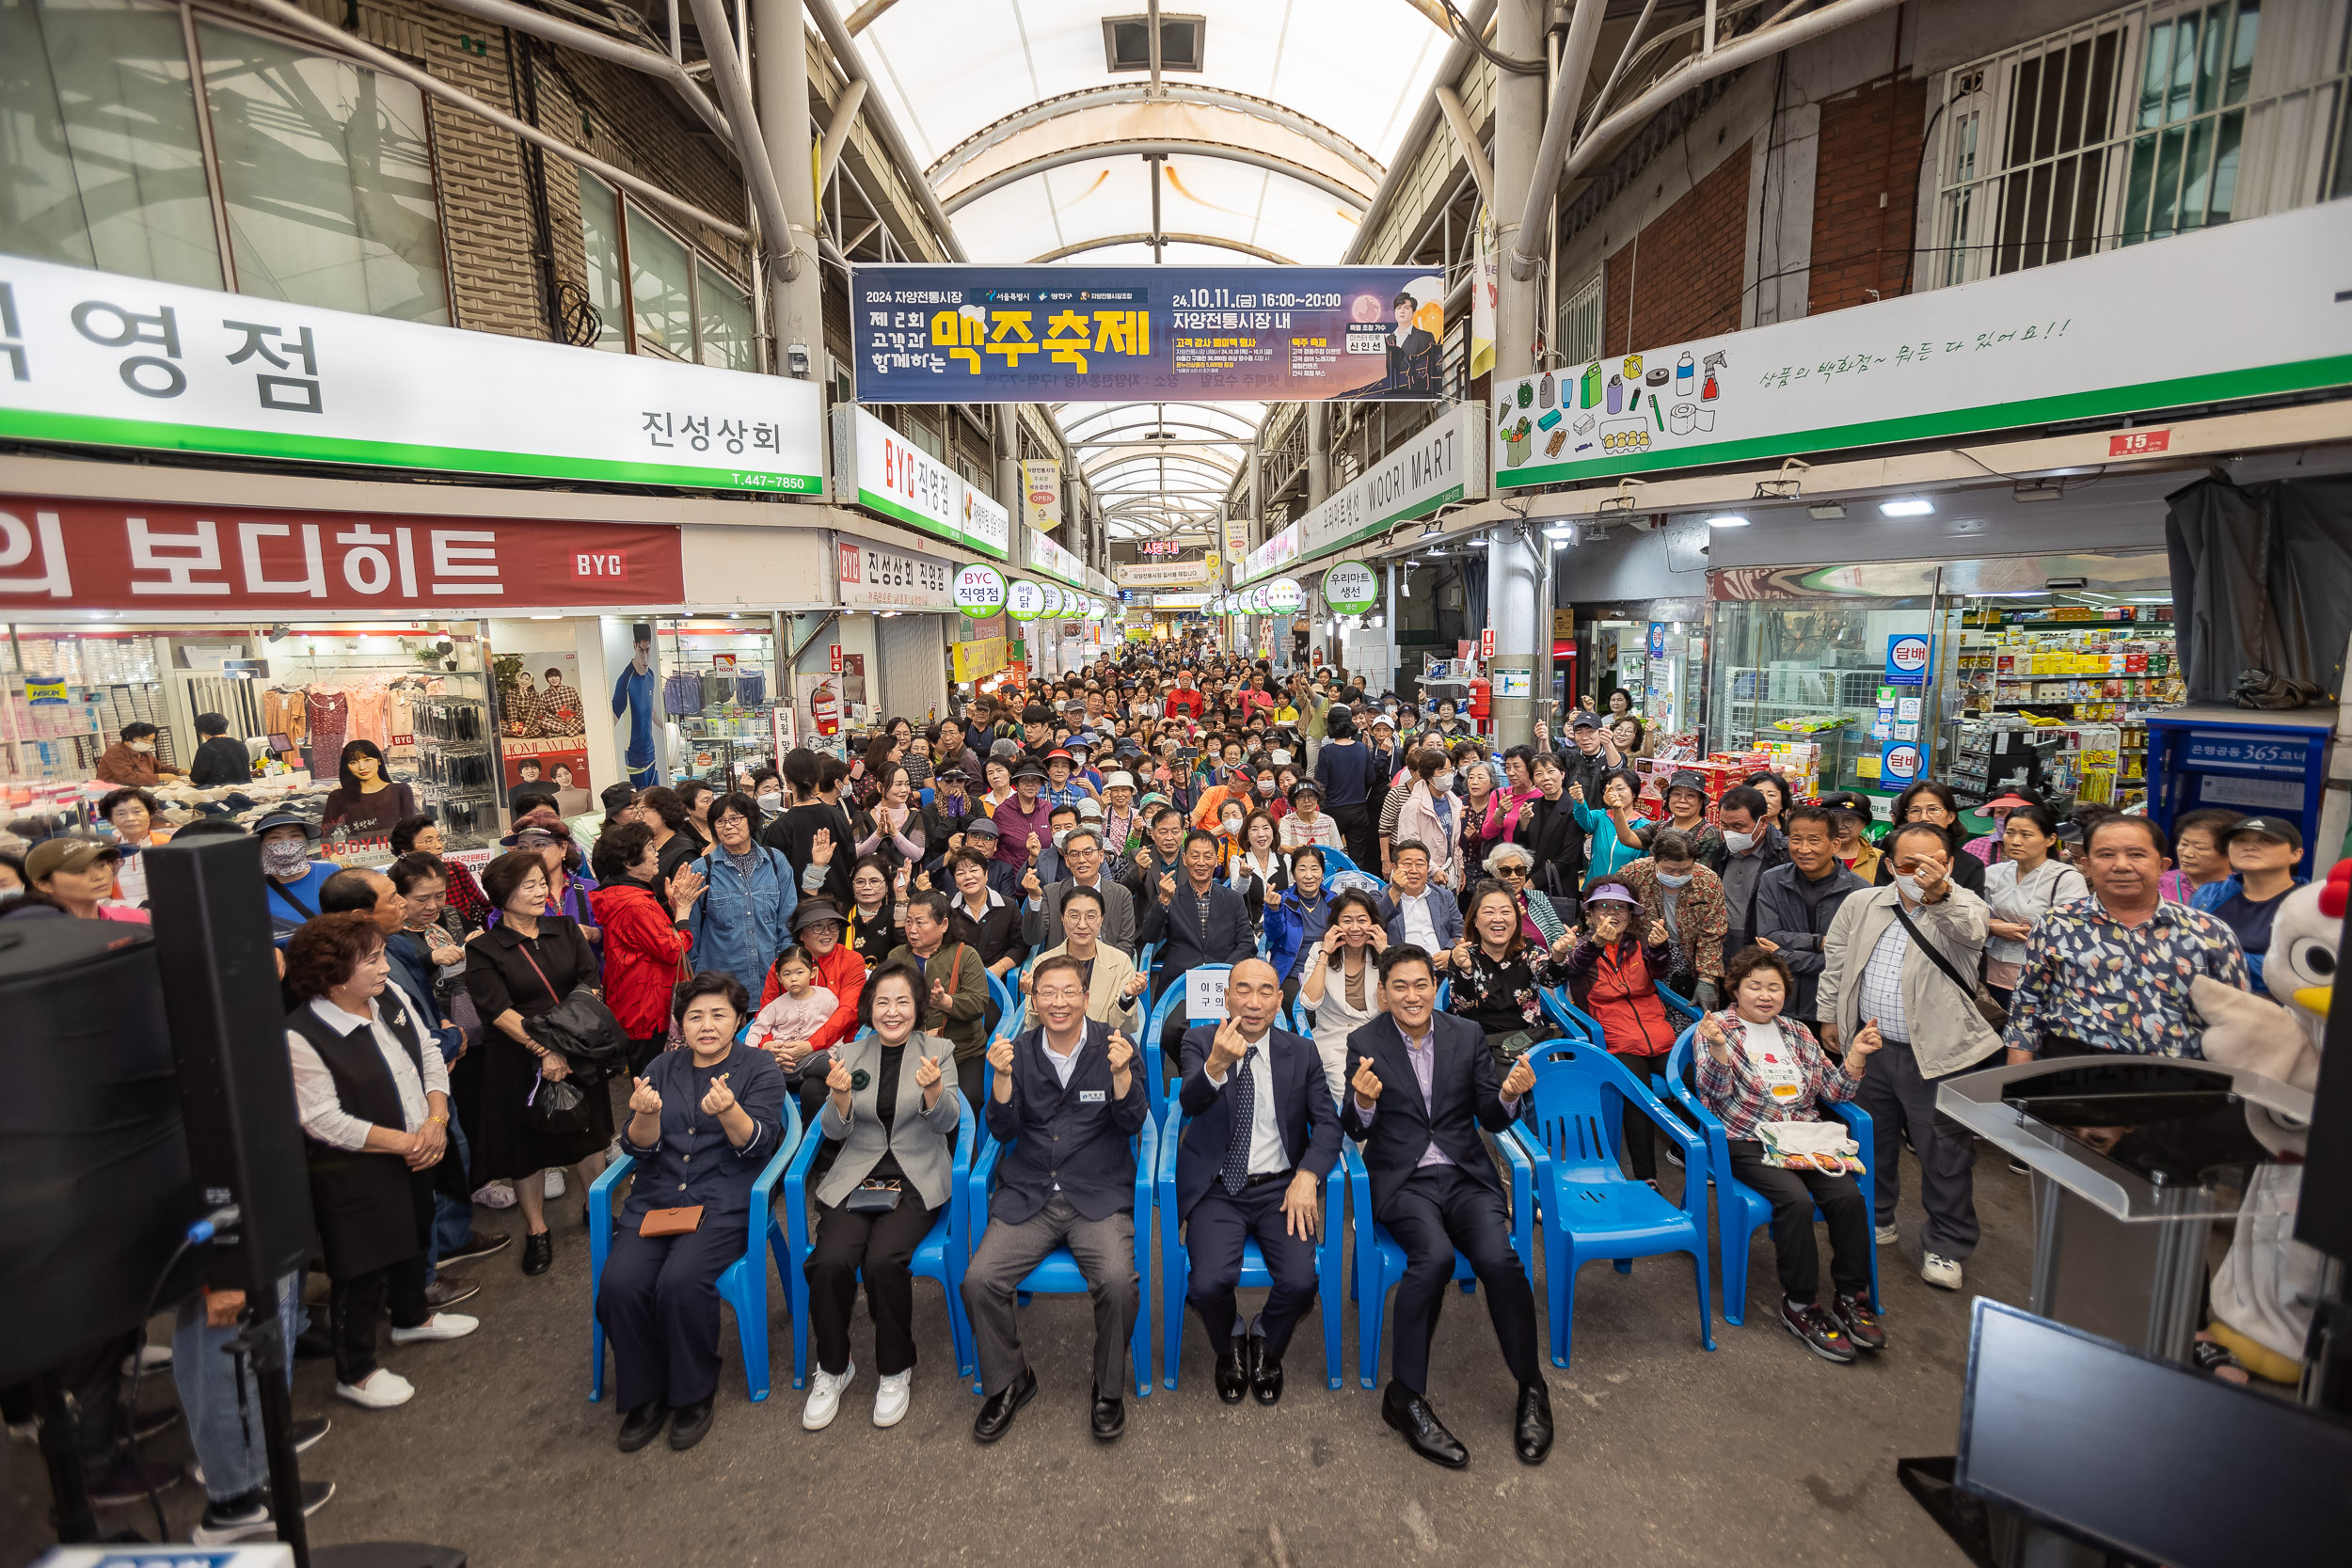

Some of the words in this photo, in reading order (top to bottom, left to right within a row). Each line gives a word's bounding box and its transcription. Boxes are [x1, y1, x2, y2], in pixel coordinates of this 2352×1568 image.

[866, 291, 892, 303] 2024
[895, 290, 963, 304] 자양전통시장
[996, 293, 1030, 301] 서울특별시
[1262, 293, 1342, 308] 16:00~20:00
[869, 311, 888, 328] 제
[895, 311, 925, 328] 2회
[1173, 312, 1271, 329] 자양전통시장
[1275, 312, 1291, 329] 내
[871, 332, 927, 352] 고객과
[1176, 338, 1193, 348] 고객
[1196, 338, 1211, 348] 감사
[1239, 338, 1256, 348] 행사
[1292, 338, 1309, 348] 맥주
[1310, 338, 1327, 348] 축제
[871, 353, 946, 374] 함께하는
[1759, 366, 1810, 389] 상품의
[1895, 342, 1933, 367] 뭐든
[1945, 341, 1964, 353] 다
[642, 411, 780, 454] 진성상회
[2124, 434, 2148, 450] 15
[885, 437, 914, 499] BYC
[918, 461, 948, 516] 직영점
[1367, 461, 1405, 513] WOORI
[1411, 428, 1454, 491] MART
[731, 473, 805, 489] T.447-7850
[126, 516, 505, 599] 보디히트
[576, 554, 623, 576] BYC
[842, 548, 859, 580] BYC
[867, 552, 914, 588] 진성상회
[919, 562, 945, 592] 직영점
[964, 572, 992, 585] BYC
[1330, 572, 1371, 586] 우리마트
[959, 587, 999, 602] 직영점
[1017, 585, 1033, 595] 하림
[1340, 585, 1360, 599] 생선
[1019, 595, 1031, 609] 닭
[1896, 646, 1926, 660] 담배
[779, 711, 789, 736] 타월
[394, 736, 412, 745] BYC
[502, 741, 543, 756] HOME
[545, 738, 588, 752] WEAR
[2191, 744, 2242, 757] 은행공동
[2243, 744, 2281, 761] 365
[2279, 752, 2306, 763] 코너
[321, 837, 373, 858] BODY
